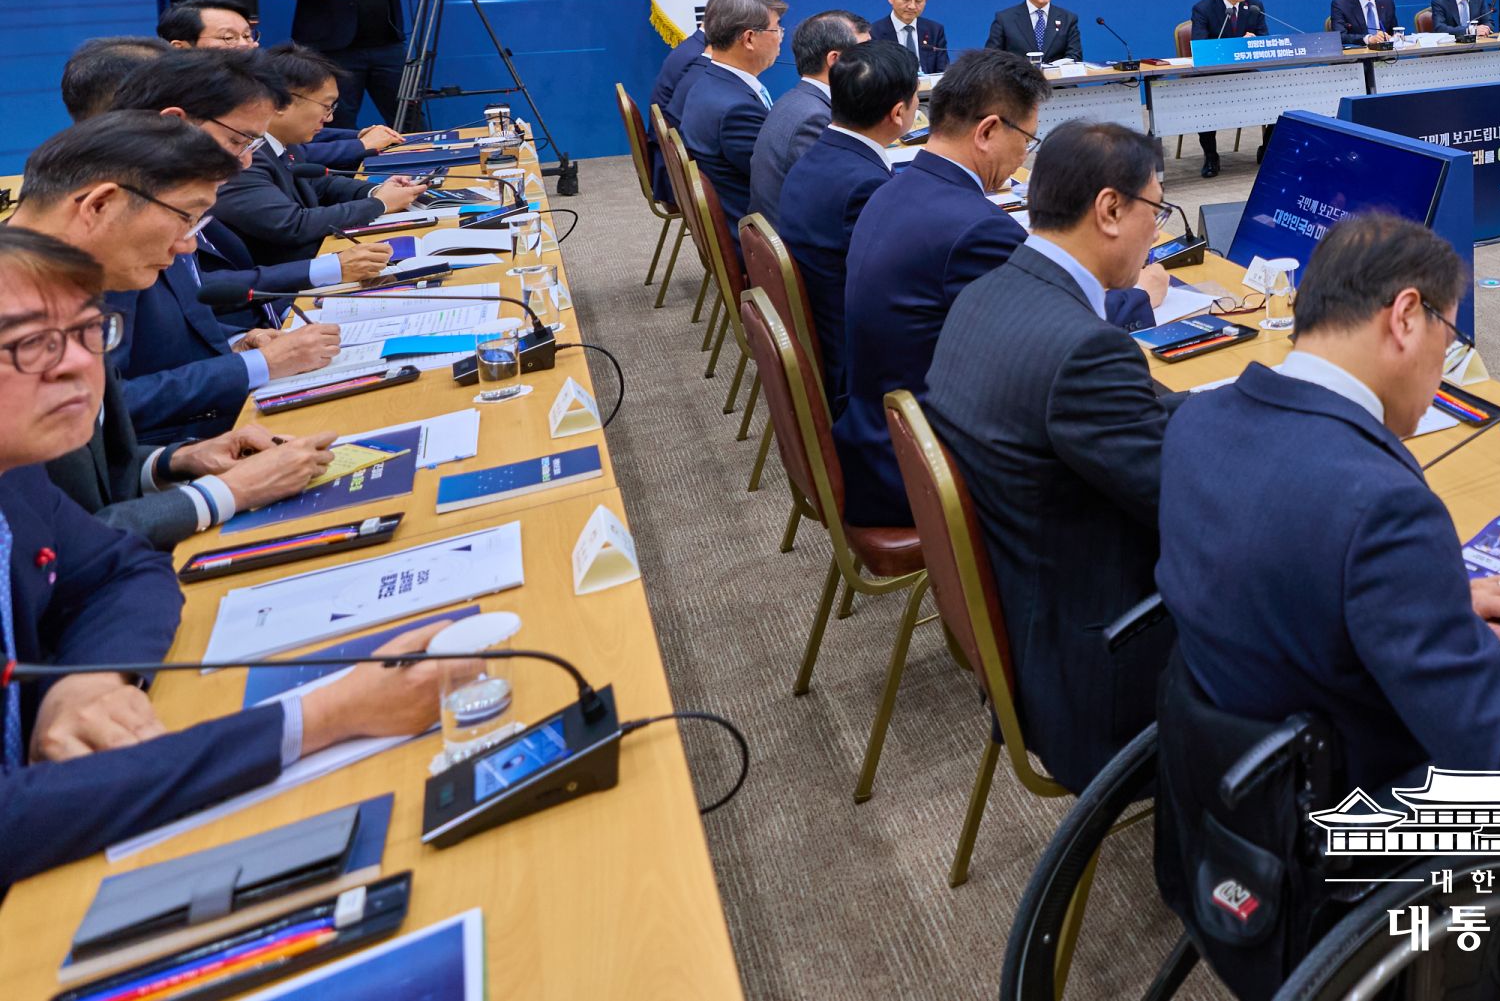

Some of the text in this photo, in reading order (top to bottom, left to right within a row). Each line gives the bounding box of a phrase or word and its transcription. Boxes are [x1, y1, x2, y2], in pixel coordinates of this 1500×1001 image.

[1294, 47, 1306, 56] 나라
[1469, 149, 1495, 165] 래를
[1297, 194, 1319, 214] 국민께
[1273, 208, 1315, 238] 대한민국의
